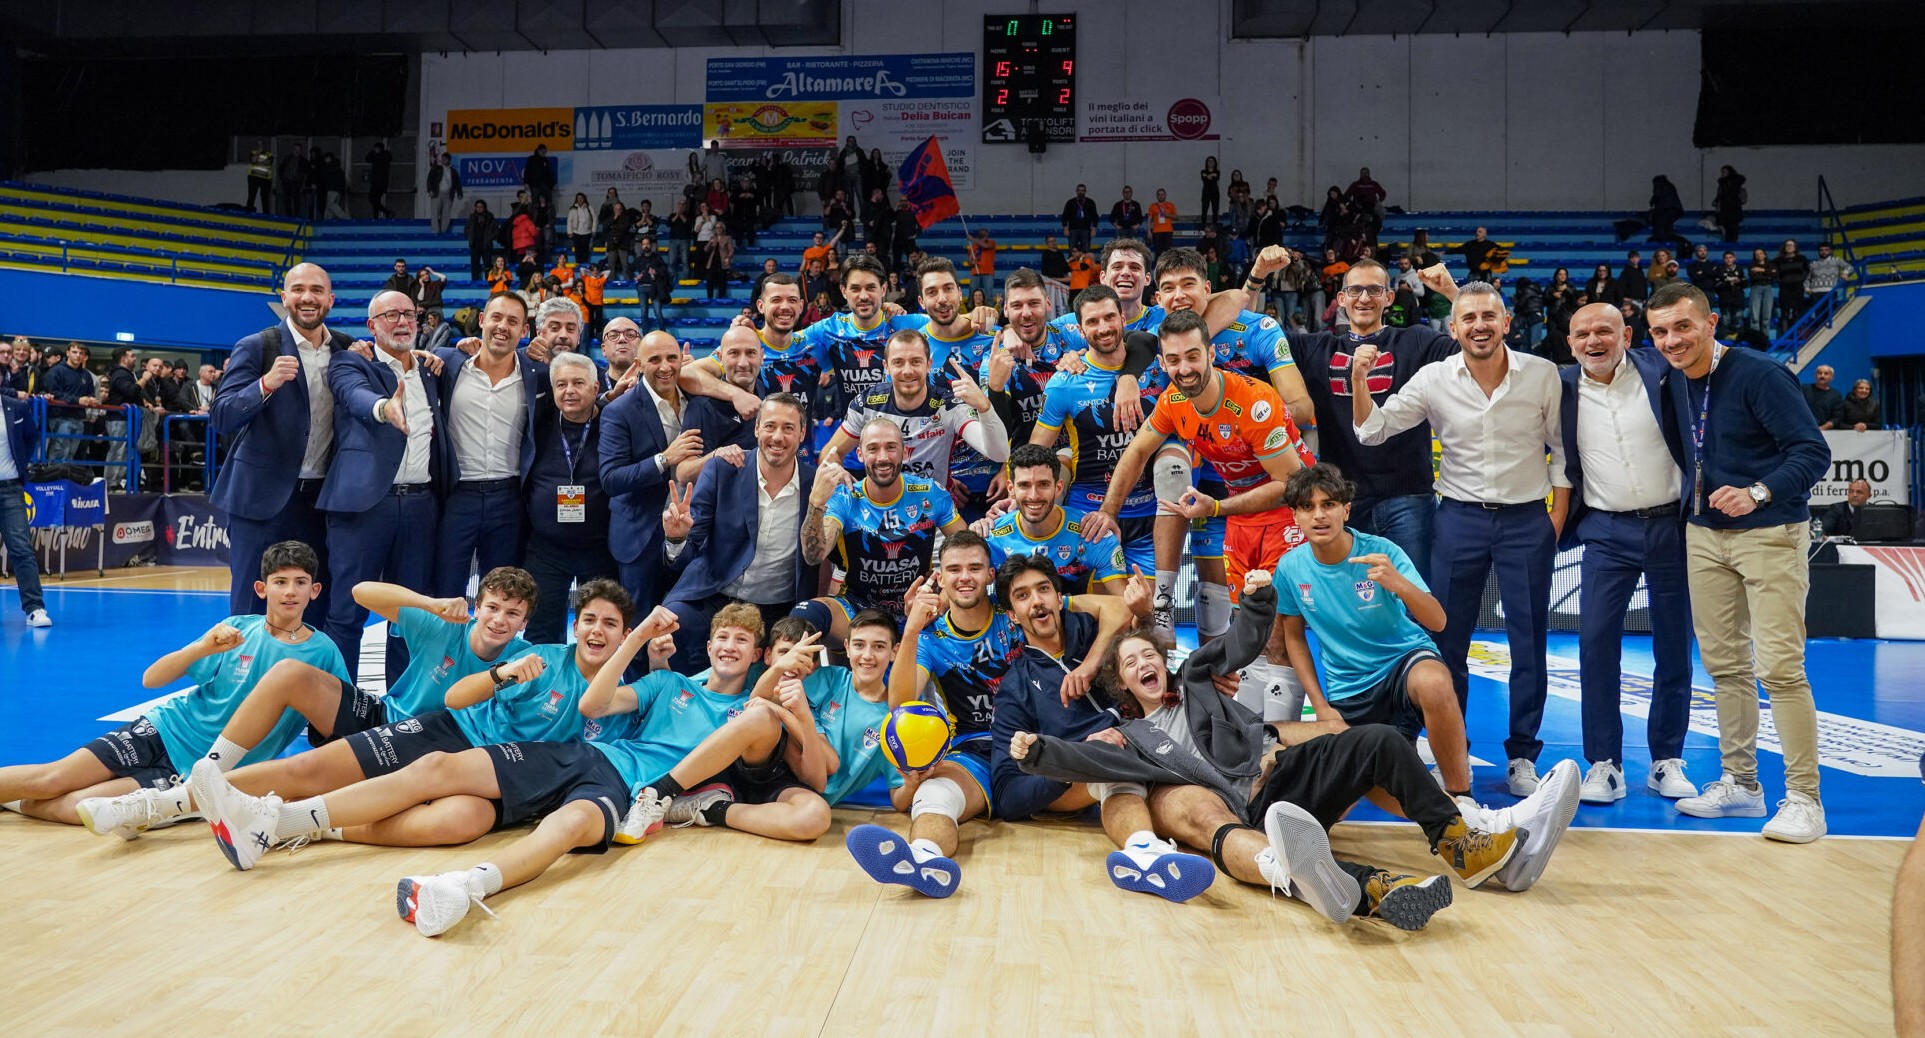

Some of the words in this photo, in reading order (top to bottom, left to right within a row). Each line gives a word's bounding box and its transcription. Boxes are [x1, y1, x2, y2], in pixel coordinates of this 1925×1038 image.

[1007, 20, 1018, 35] 0
[1041, 20, 1053, 35] 0
[805, 61, 849, 69] RISTORANTE
[995, 61, 1011, 77] 15
[1062, 60, 1073, 76] 9
[997, 89, 1009, 105] 2
[1059, 88, 1071, 104] 2
[917, 102, 970, 110] DENTISTICO
[1097, 102, 1130, 112] meglio
[1133, 102, 1148, 110] dei
[763, 112, 778, 124] M
[901, 112, 929, 121] Delia
[933, 111, 971, 120] Buican
[1089, 114, 1107, 122] vini
[1110, 114, 1145, 122] italiani
[1170, 113, 1208, 124] Spopp
[450, 121, 571, 139] McDonald's
[1021, 126, 1074, 135] ANSORI
[1088, 126, 1125, 135] portata
[1140, 124, 1162, 132] click
[782, 150, 831, 166] Patrick
[948, 165, 970, 173] RAND
[467, 177, 513, 185] FERRAMENTA
[596, 171, 652, 181] TOMAIFICIO
[657, 170, 681, 179] ROSY
[840, 368, 882, 382] YUAS
[1077, 398, 1110, 407] SANTON
[901, 419, 910, 436] 4
[1197, 422, 1214, 443] 44
[925, 429, 945, 439] faip
[1096, 433, 1138, 448] YUA
[902, 461, 934, 473] ASA
[1812, 485, 1823, 496] di
[1827, 485, 1849, 496] fer
[883, 509, 900, 529] 15
[992, 526, 1012, 536] COBIT
[860, 555, 920, 574] YUASA
[859, 567, 920, 585] BATTERY
[1356, 581, 1374, 590] M&G
[974, 637, 995, 664] 21
[587, 720, 601, 732] M&G
[867, 729, 880, 740] M&G
[122, 739, 140, 765] BATTERY
[381, 736, 399, 764] BATTERY
